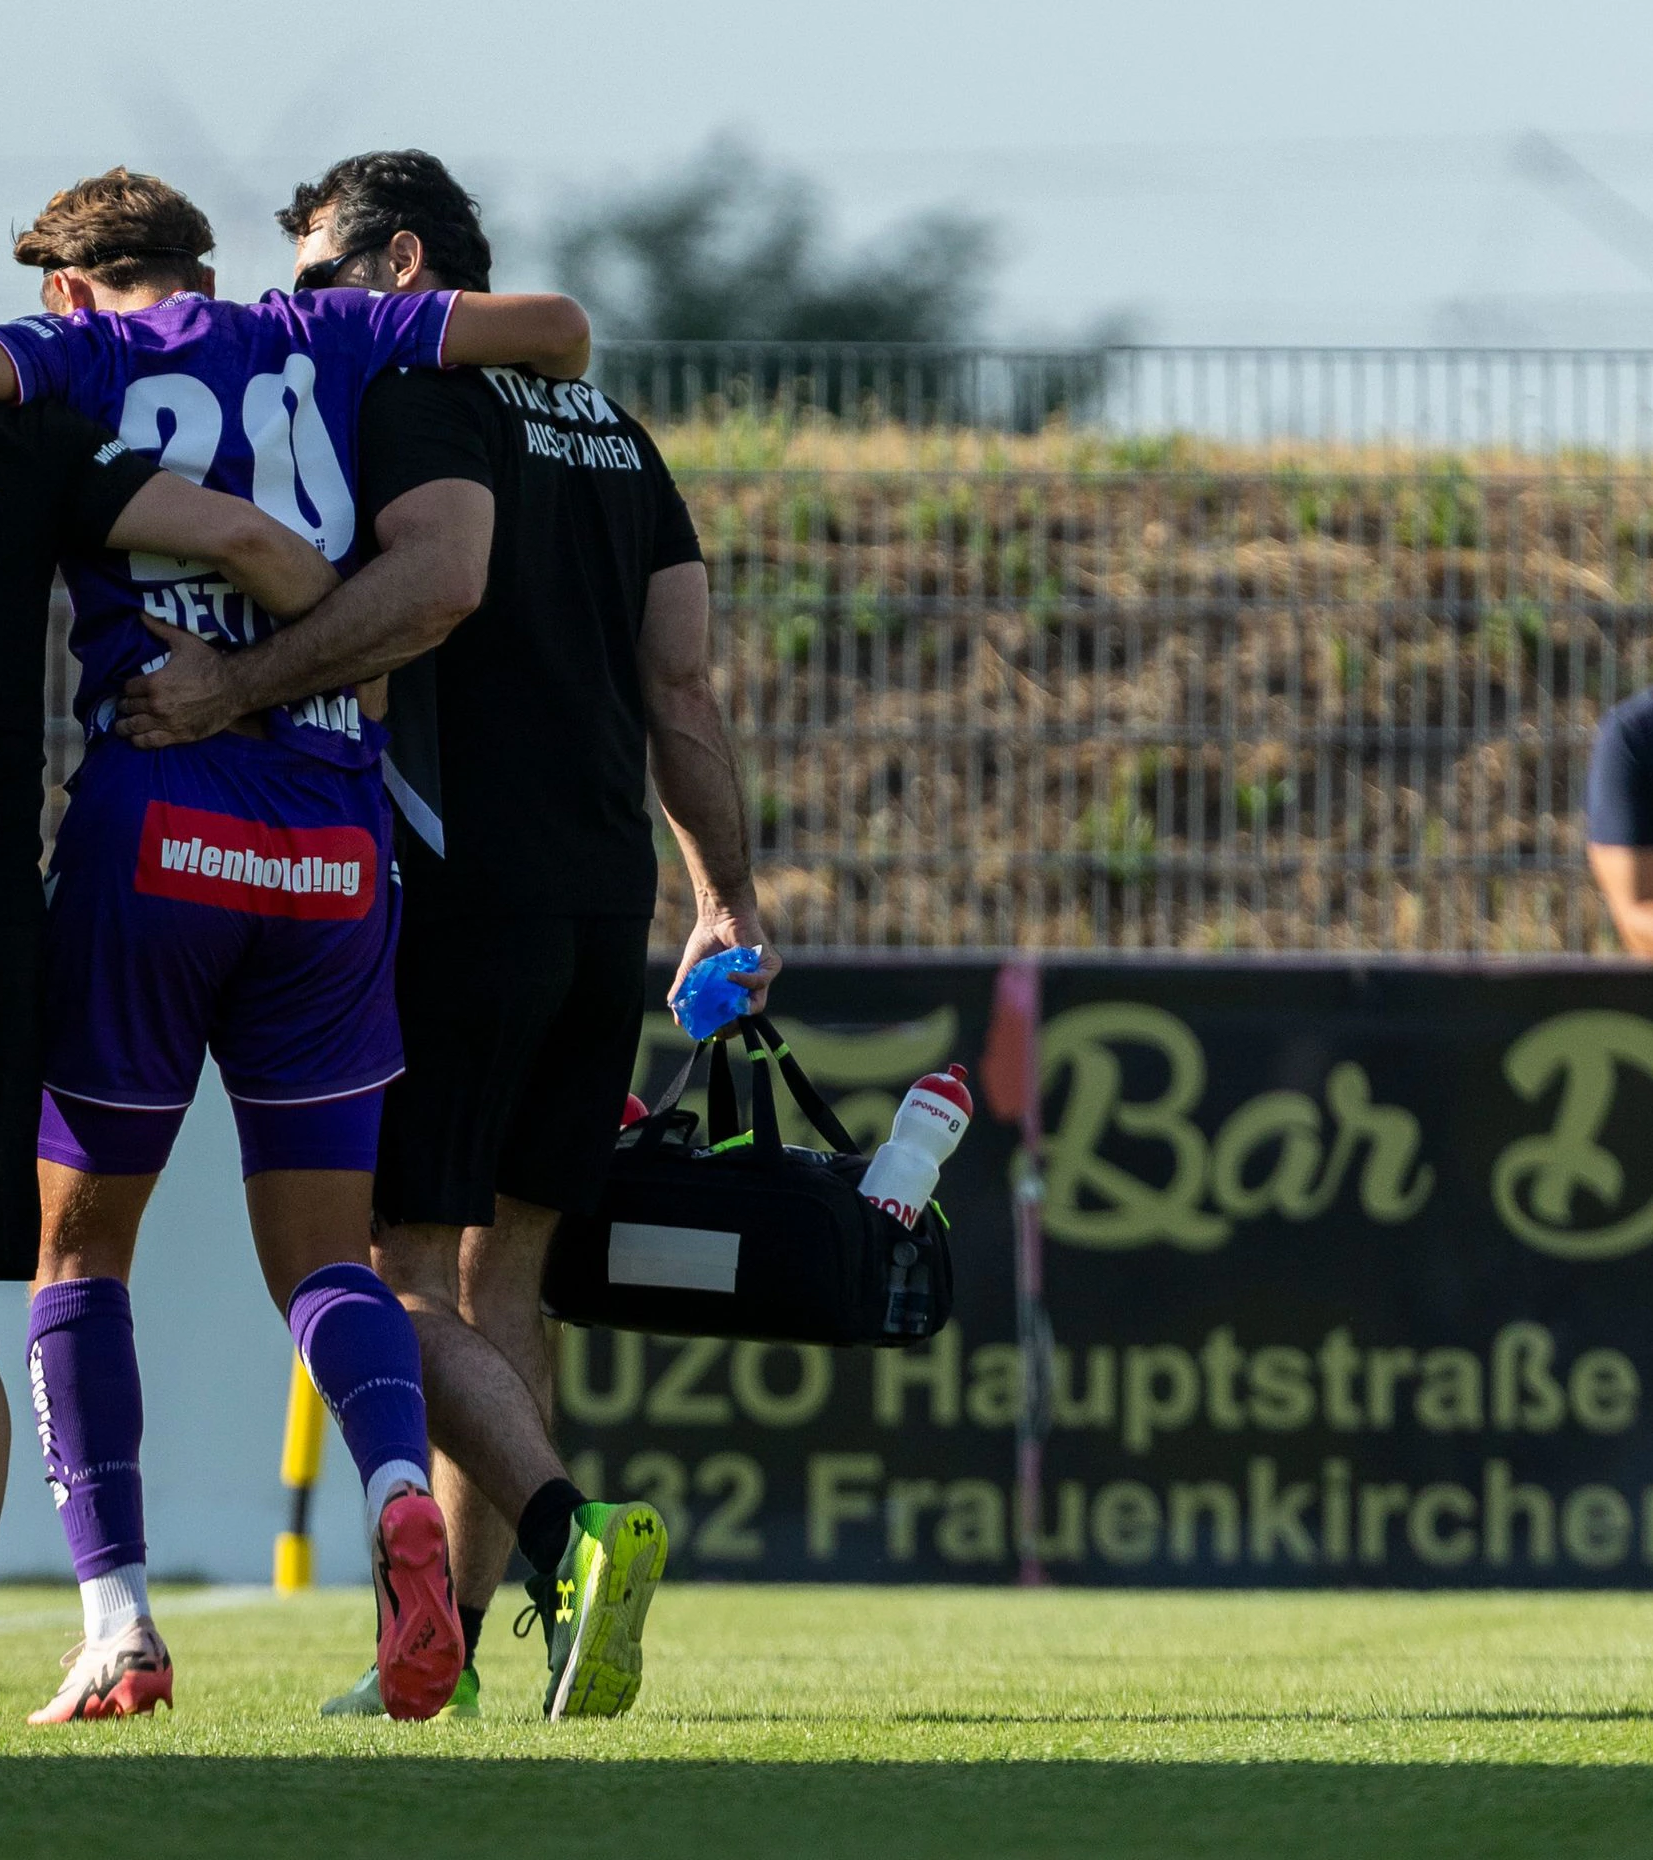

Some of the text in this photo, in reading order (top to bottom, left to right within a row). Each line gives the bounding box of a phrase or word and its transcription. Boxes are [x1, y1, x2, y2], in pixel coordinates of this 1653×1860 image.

[910, 1099, 951, 1122] SPONSER
[1011, 1002, 1436, 1254] Bar
[872, 1318, 1640, 1454] Hauptstraße
[805, 1452, 1653, 1566] Frauenkirche
